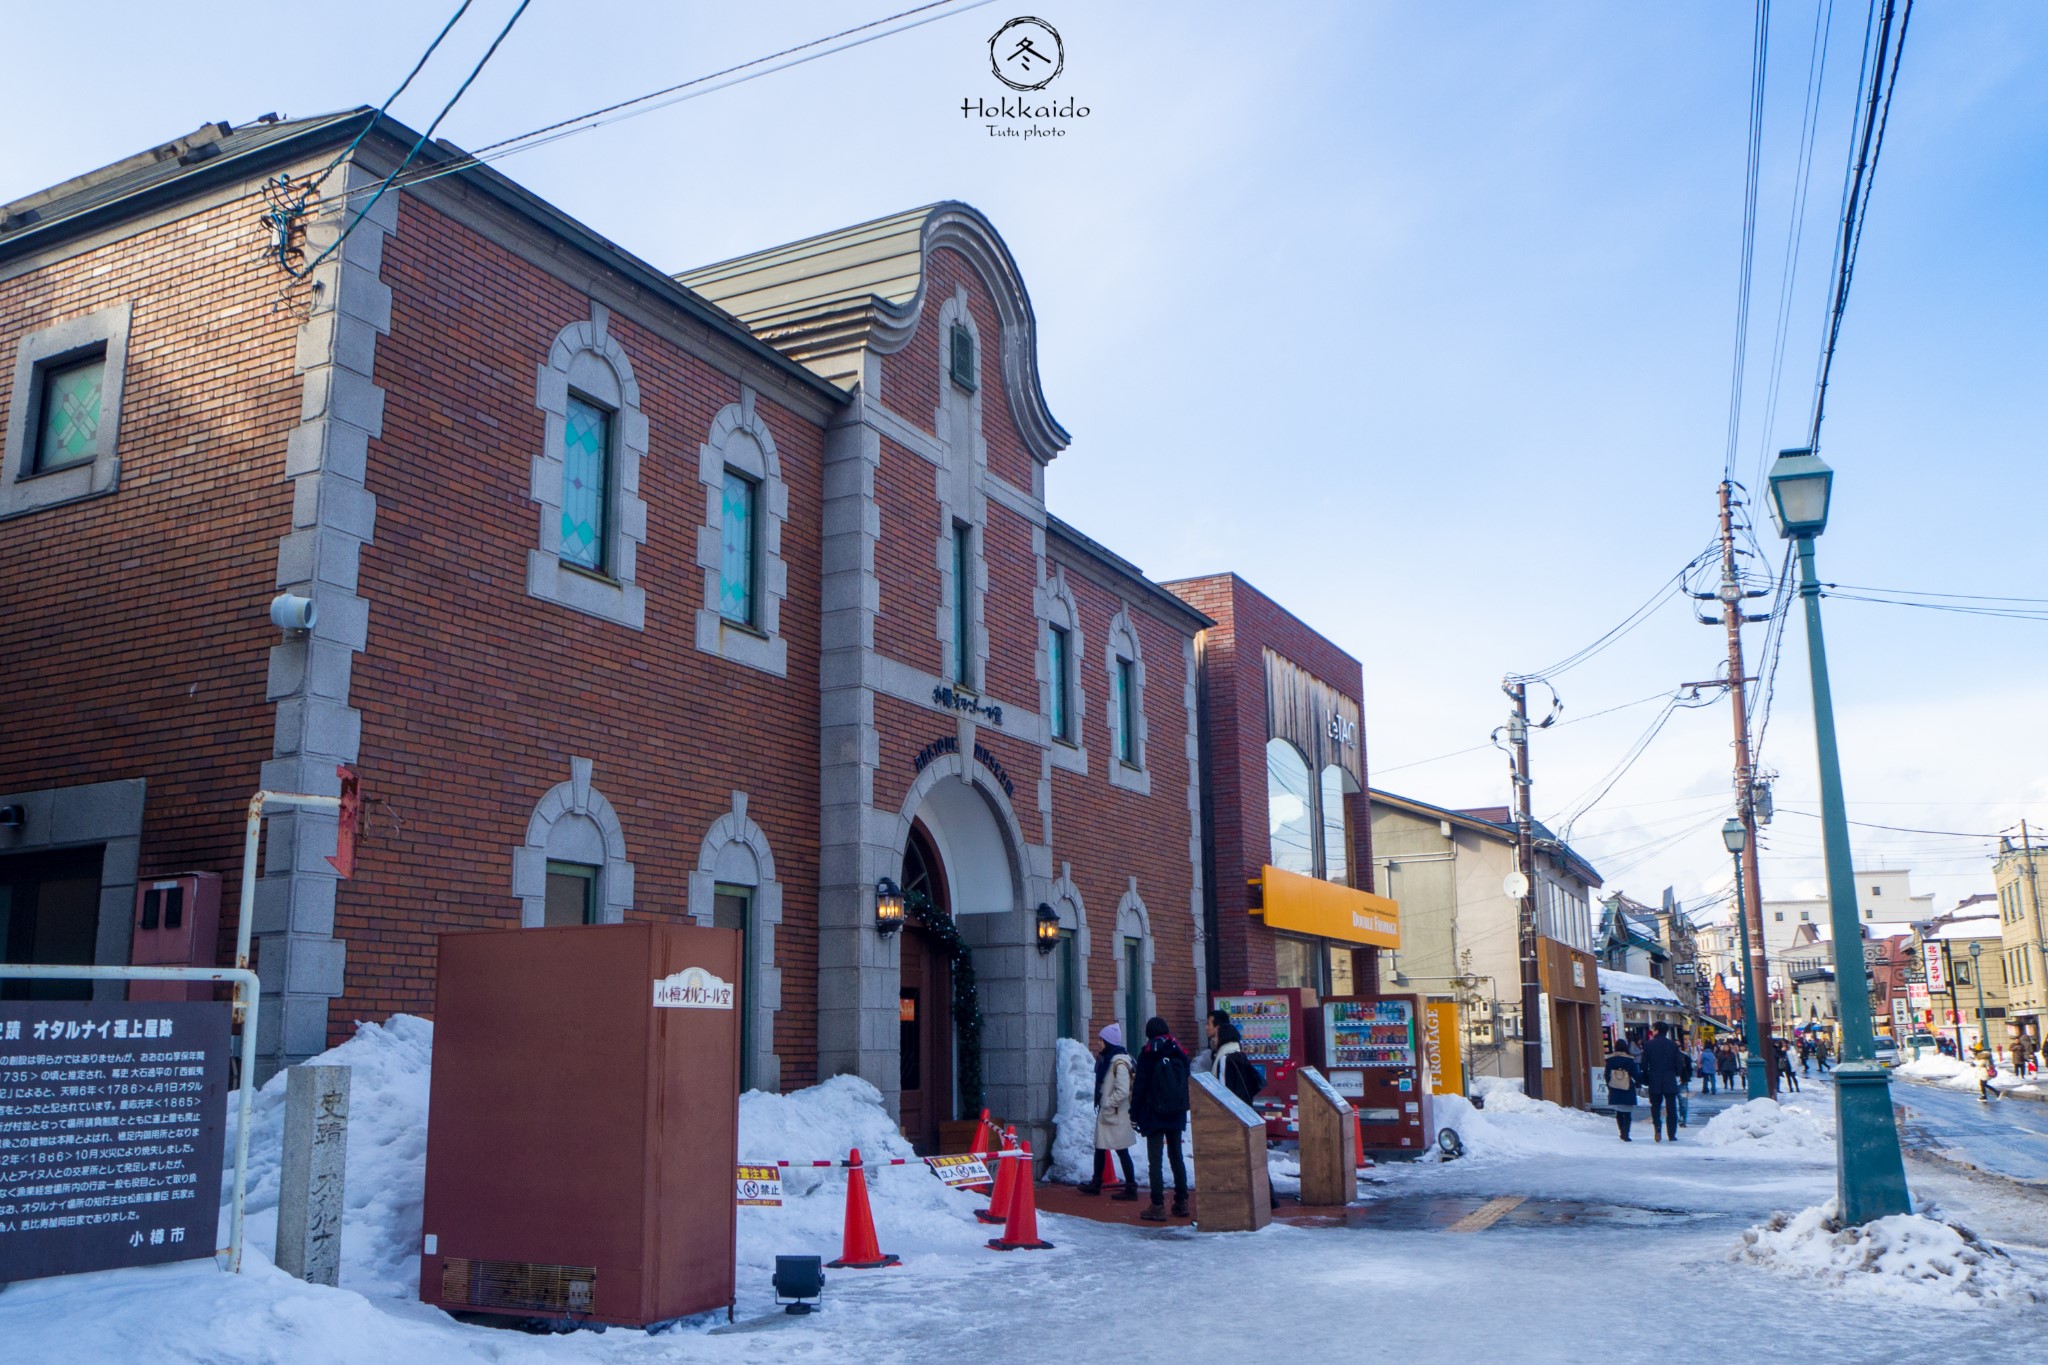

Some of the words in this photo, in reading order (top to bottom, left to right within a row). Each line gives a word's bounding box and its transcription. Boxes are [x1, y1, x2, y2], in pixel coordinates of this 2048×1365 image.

[658, 986, 731, 1005] 小樽オルゴール堂
[33, 1018, 173, 1040] オタルナイ運上屋跡
[1427, 1008, 1443, 1087] FROMAGE
